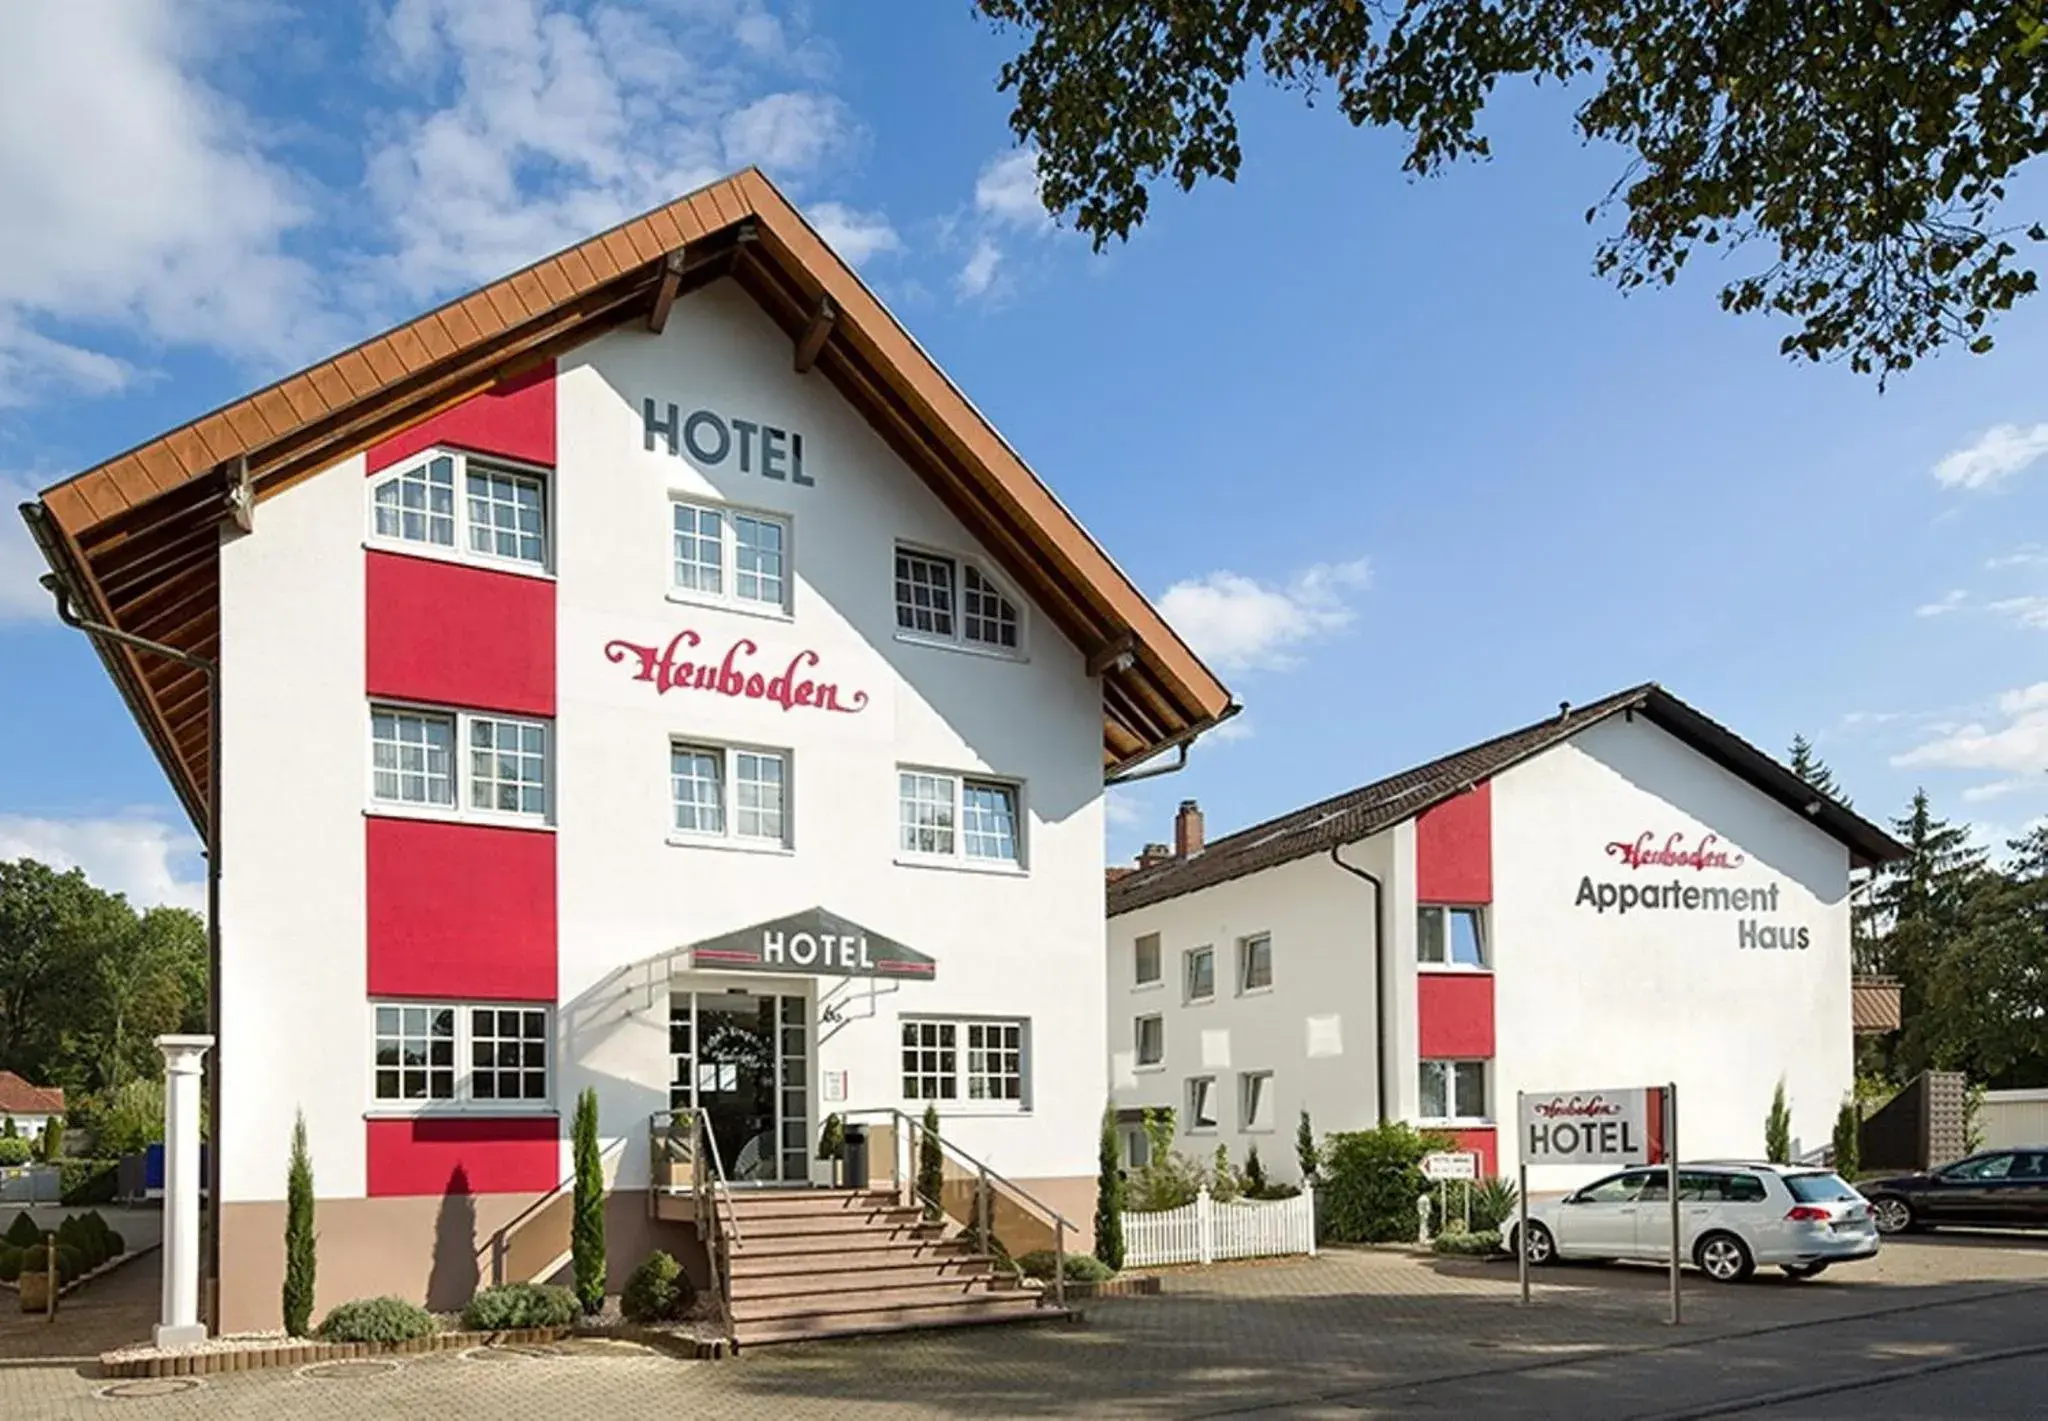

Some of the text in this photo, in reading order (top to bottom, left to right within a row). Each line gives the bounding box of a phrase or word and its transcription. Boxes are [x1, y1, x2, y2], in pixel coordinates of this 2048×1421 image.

[643, 397, 815, 487] HOTEL
[605, 630, 868, 713] Heuboden
[1605, 831, 1744, 870] Heuboden
[1575, 875, 1779, 914] Appartement
[763, 930, 875, 968] HOTEL
[1738, 919, 1810, 949] Haus
[1530, 1121, 1639, 1154] HOTEL
